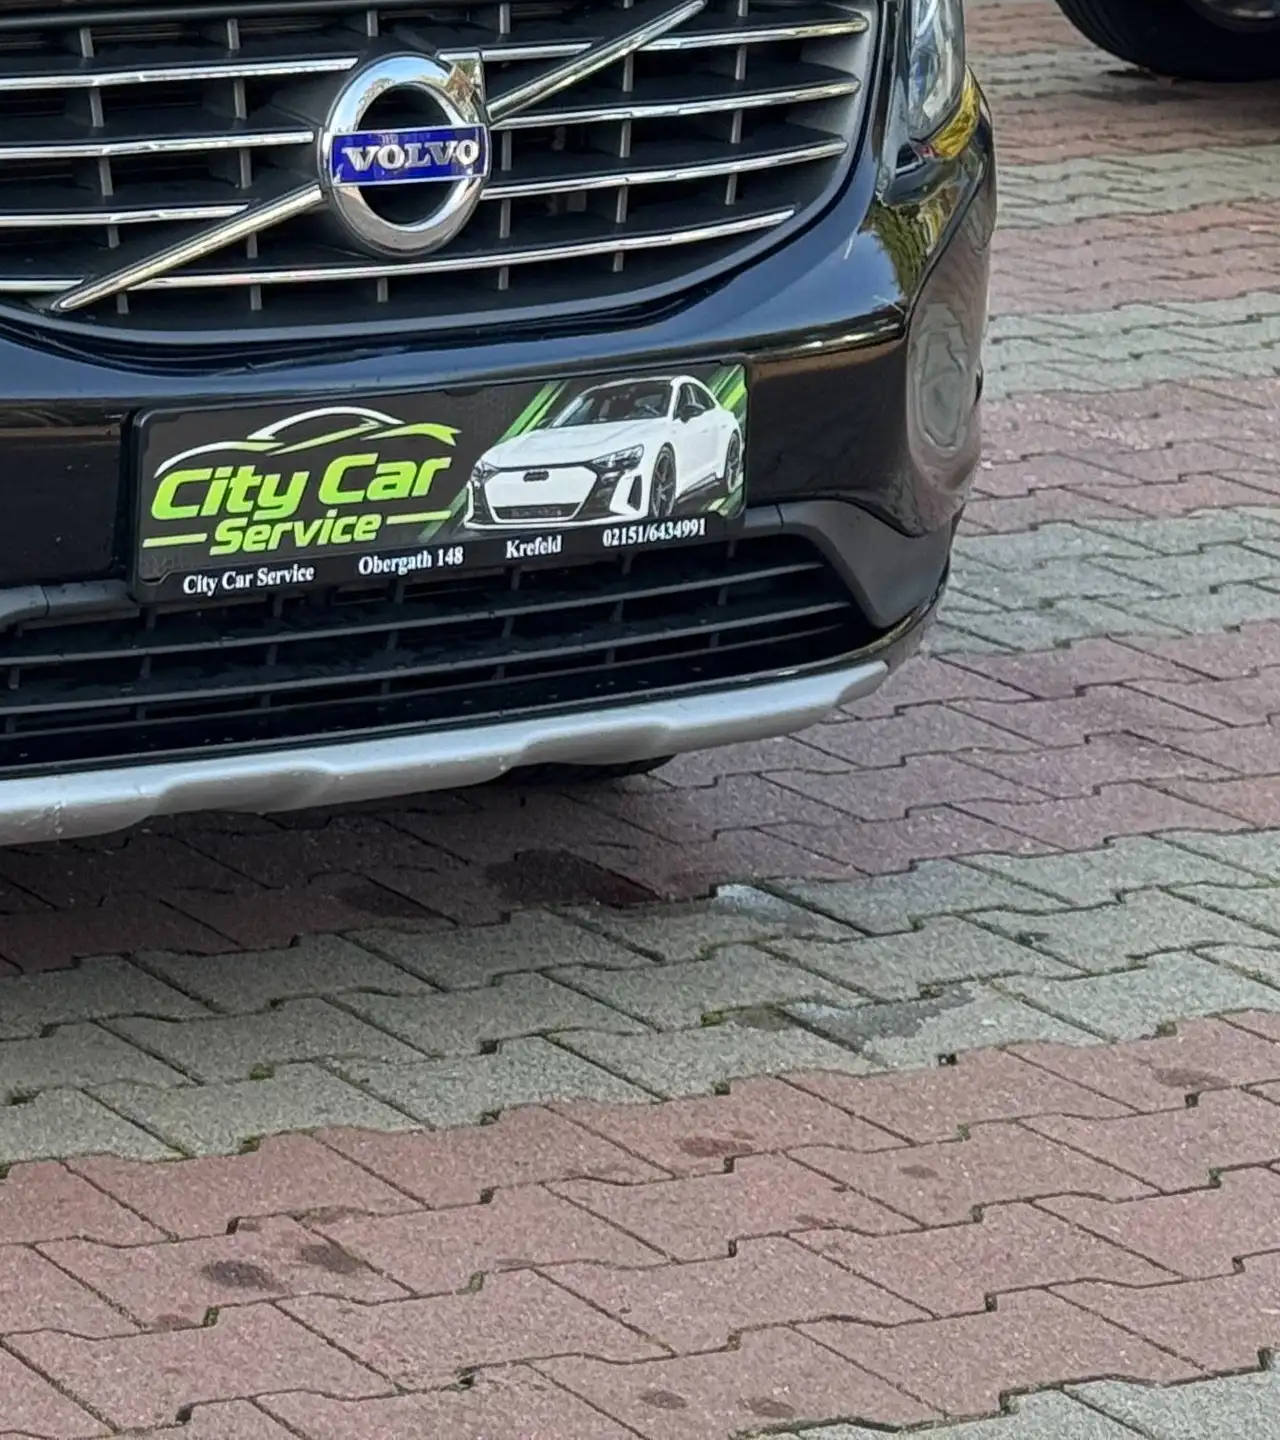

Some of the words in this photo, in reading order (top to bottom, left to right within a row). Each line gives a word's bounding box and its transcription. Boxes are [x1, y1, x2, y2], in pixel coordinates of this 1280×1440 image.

[341, 139, 479, 172] VOLVO
[151, 464, 310, 521] City
[318, 452, 452, 505] Car
[183, 574, 218, 597] City
[222, 570, 254, 590] Car
[256, 563, 315, 587] Service
[358, 547, 432, 576] Obergath
[436, 545, 464, 567] 148
[505, 534, 563, 559] Krefeld
[602, 517, 707, 548] 02151/6434991
[209, 509, 382, 556] Service
